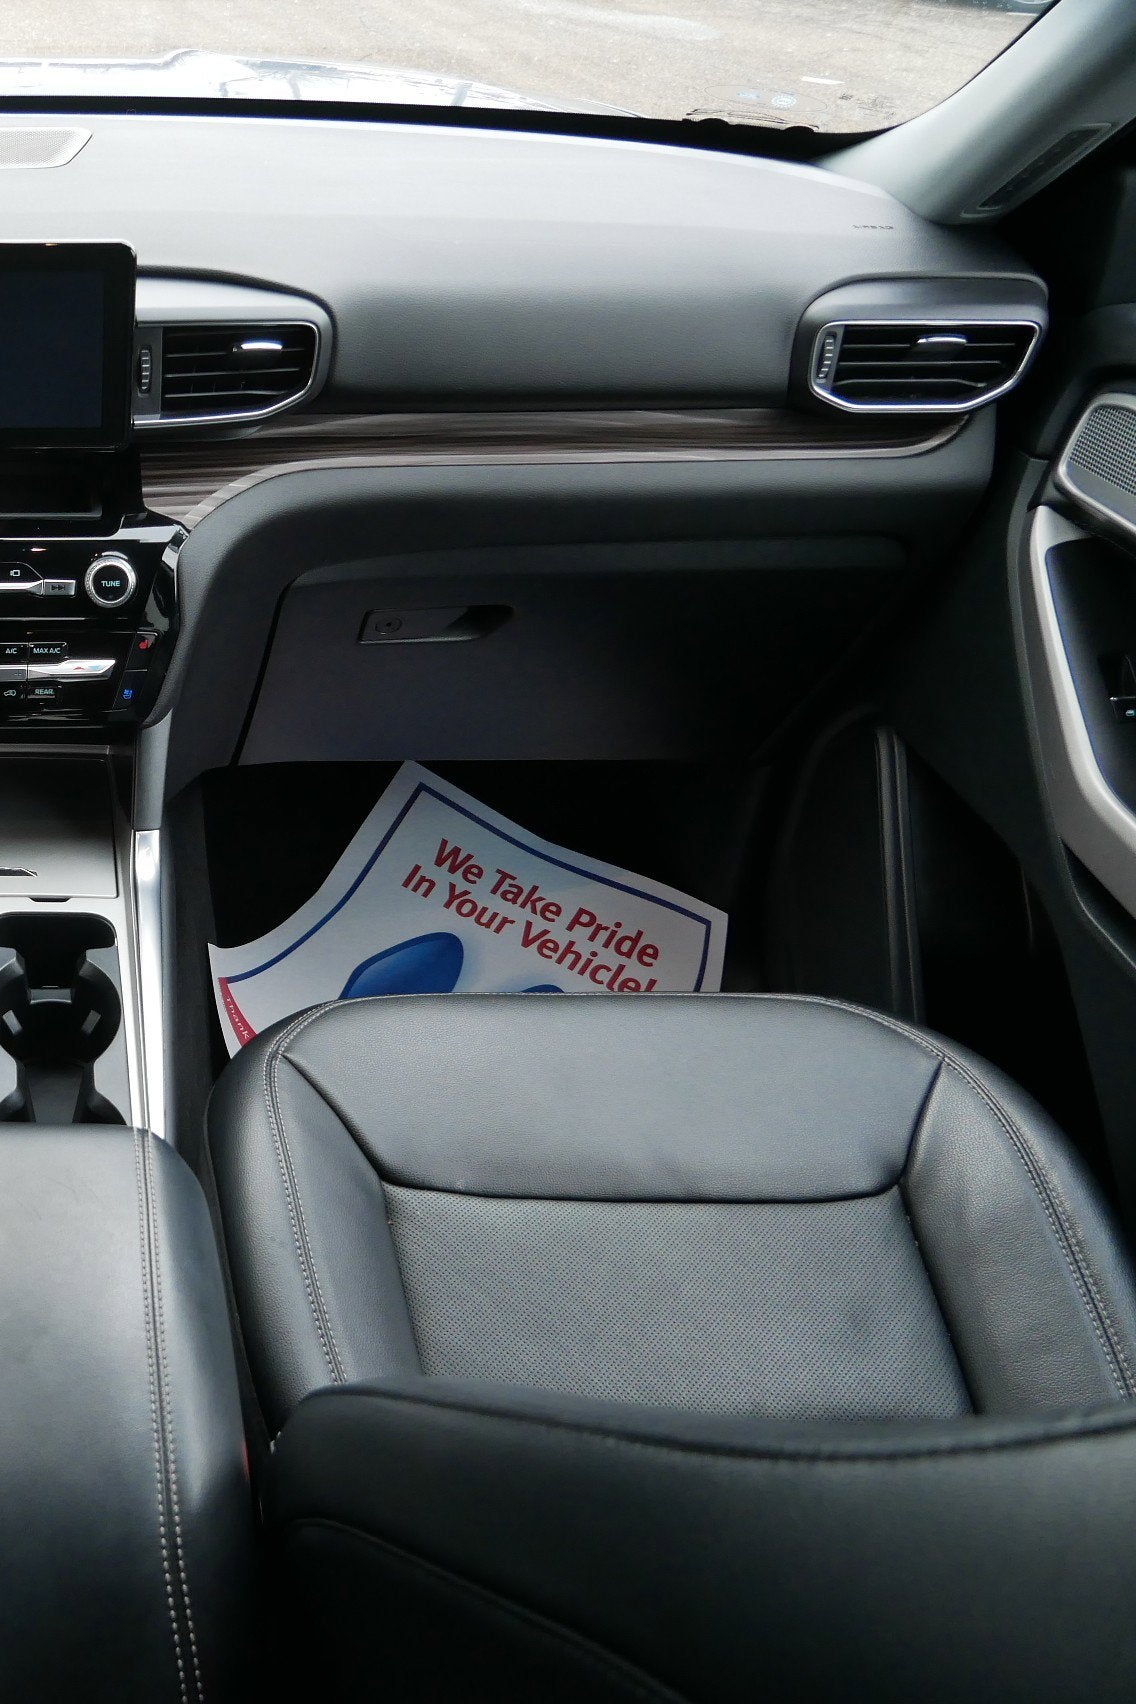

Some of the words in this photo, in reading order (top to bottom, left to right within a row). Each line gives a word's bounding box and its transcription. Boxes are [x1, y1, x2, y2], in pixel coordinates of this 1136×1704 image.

[100, 580, 121, 588] TUNE
[401, 864, 436, 898] In
[442, 882, 515, 934] Your
[520, 920, 658, 993] Vehicle!
[434, 838, 484, 884] We
[490, 868, 562, 923] Take
[565, 907, 659, 967] Pride
